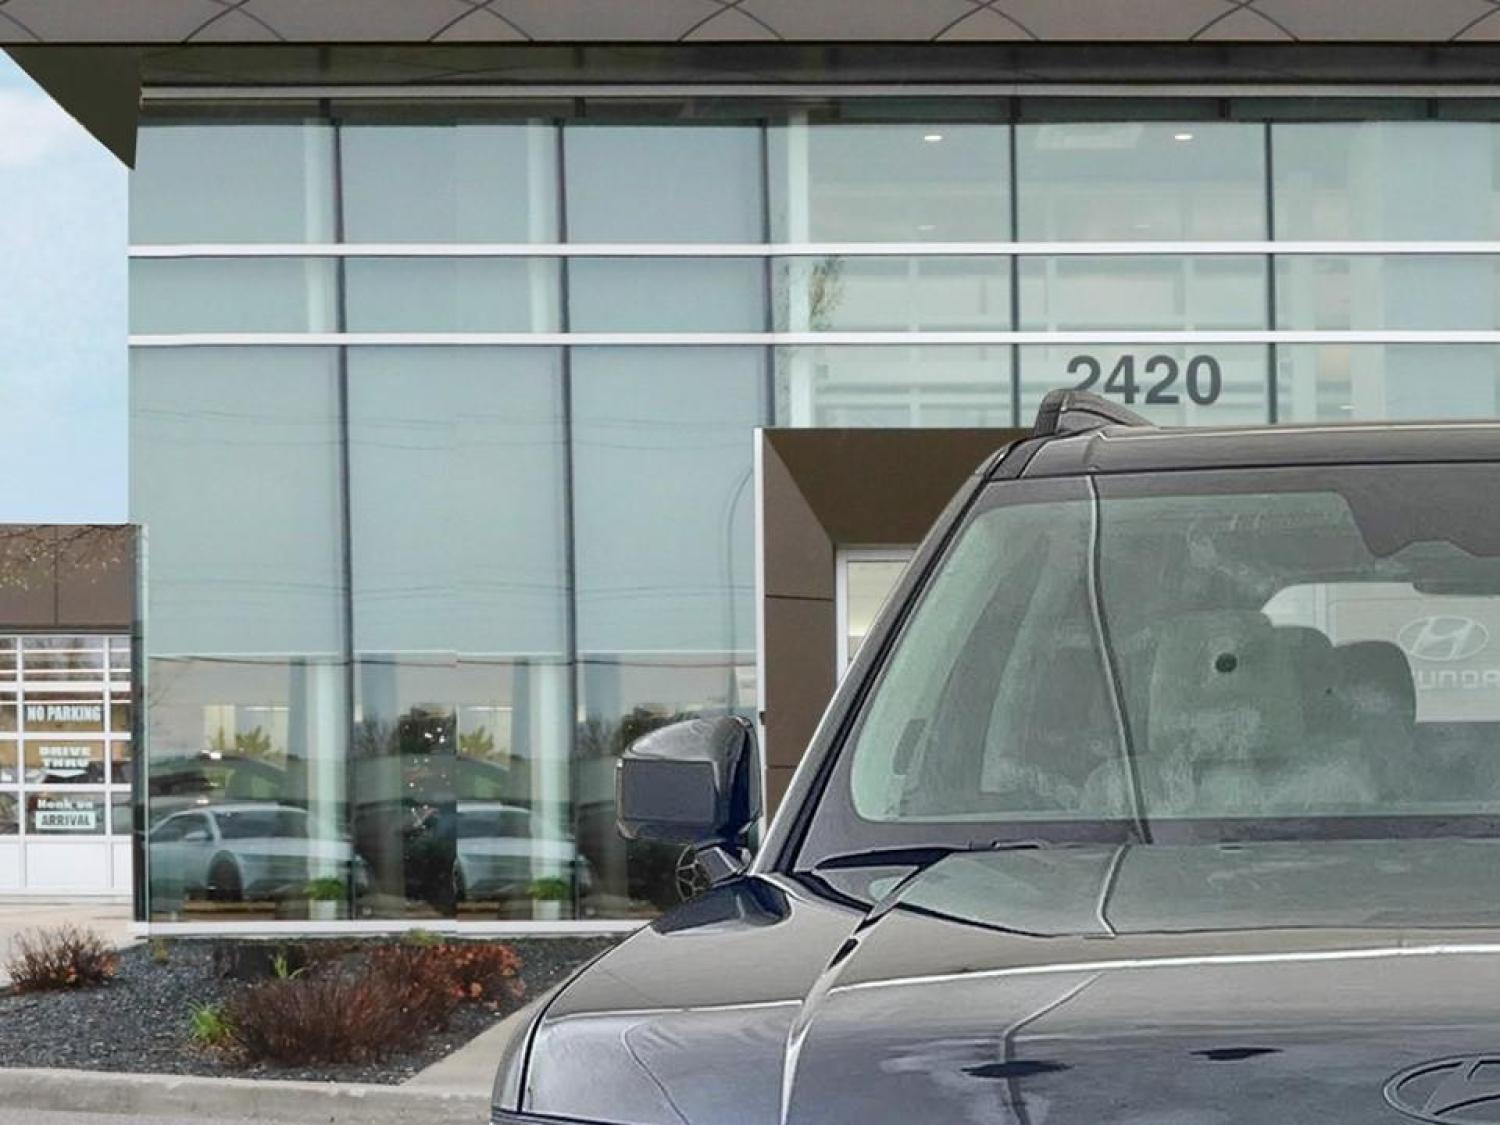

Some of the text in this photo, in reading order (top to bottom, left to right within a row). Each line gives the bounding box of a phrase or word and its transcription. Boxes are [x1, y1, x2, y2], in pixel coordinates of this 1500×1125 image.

[1066, 354, 1222, 406] 2420
[27, 706, 101, 721] NO PARKING
[39, 746, 91, 757] DRIVE
[41, 813, 91, 826] ARRIVAL
